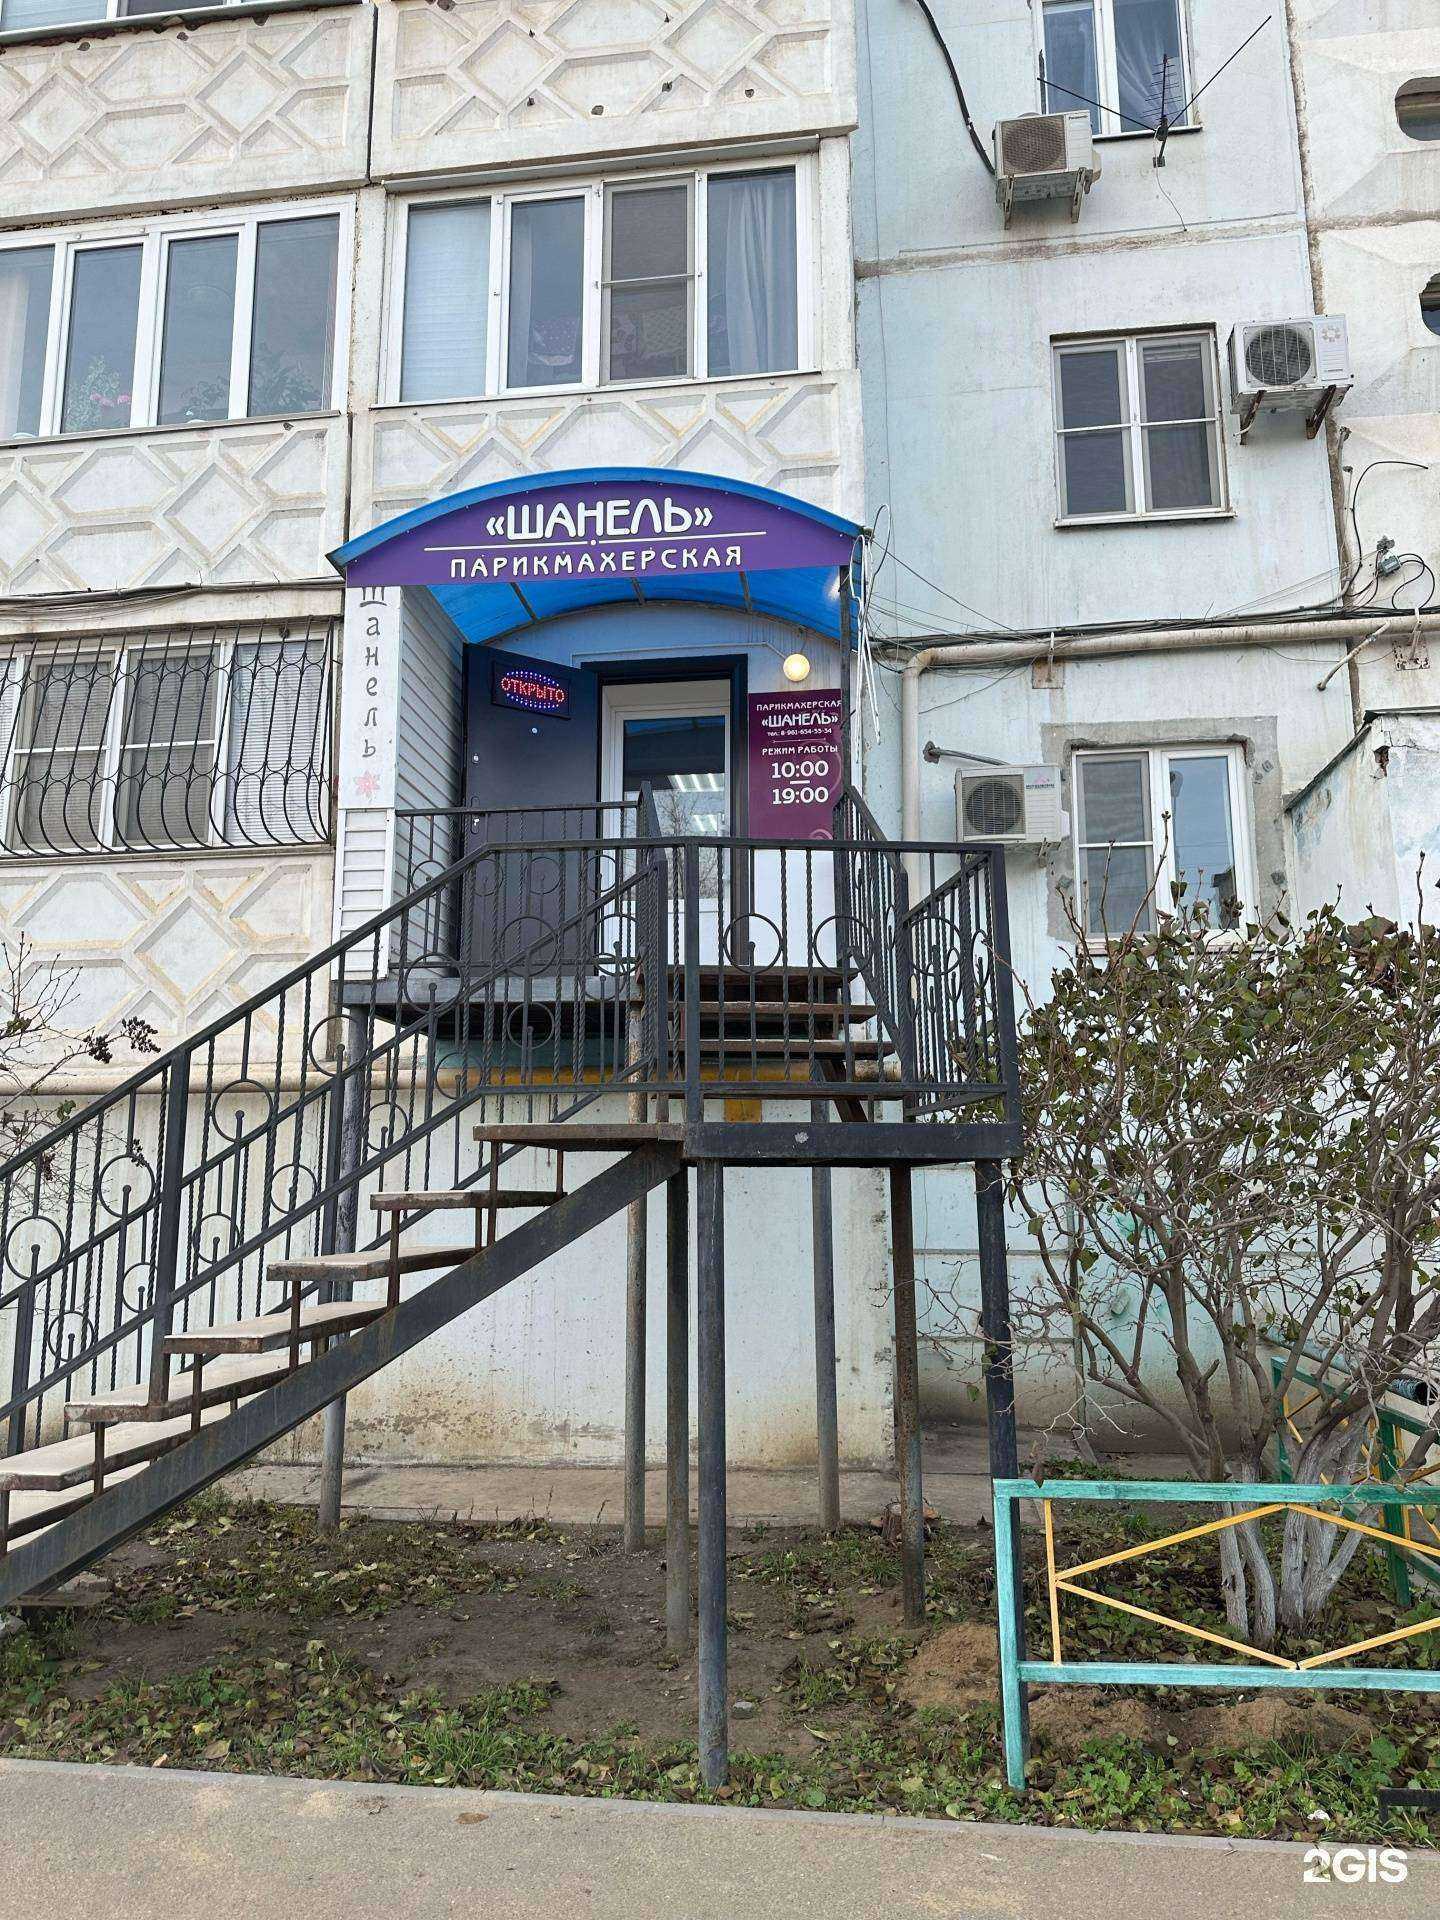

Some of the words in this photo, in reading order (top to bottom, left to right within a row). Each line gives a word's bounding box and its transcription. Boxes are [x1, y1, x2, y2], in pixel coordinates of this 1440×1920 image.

[485, 497, 713, 540] «ШАНЕЛЬ»
[450, 546, 742, 578] ПАРИКМАХЕРСКАЯ
[501, 677, 565, 702] ОТКРЫТО
[756, 700, 842, 711] ПАРИКМАХЕРСКАЯ
[761, 712, 839, 728] «ШАНЕЛЬ»
[762, 747, 795, 756] РЕЖИМ
[797, 745, 838, 754] РАБОТЫ
[771, 760, 829, 779] 10:00
[772, 786, 829, 805] 19:00
